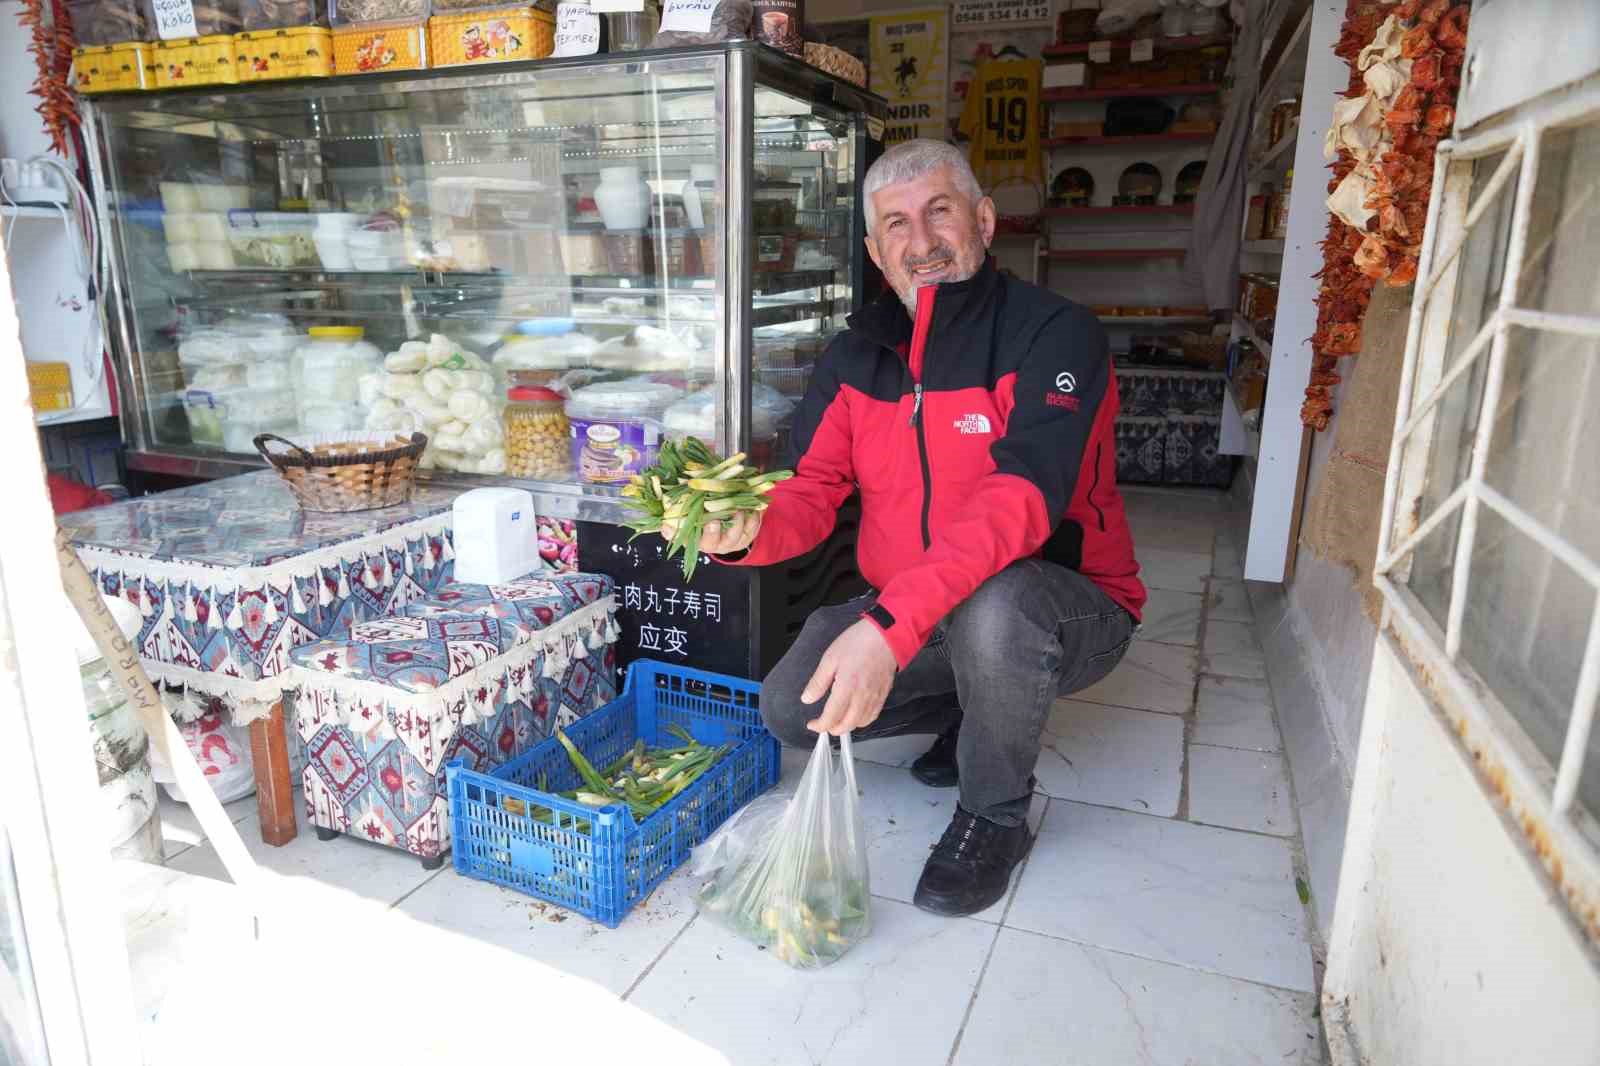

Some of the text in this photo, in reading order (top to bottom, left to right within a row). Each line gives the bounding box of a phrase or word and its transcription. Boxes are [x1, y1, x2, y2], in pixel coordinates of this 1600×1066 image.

[886, 104, 930, 120] NDIR
[985, 97, 1027, 146] 49
[883, 124, 919, 140] MMİ
[639, 622, 688, 656] 应变
